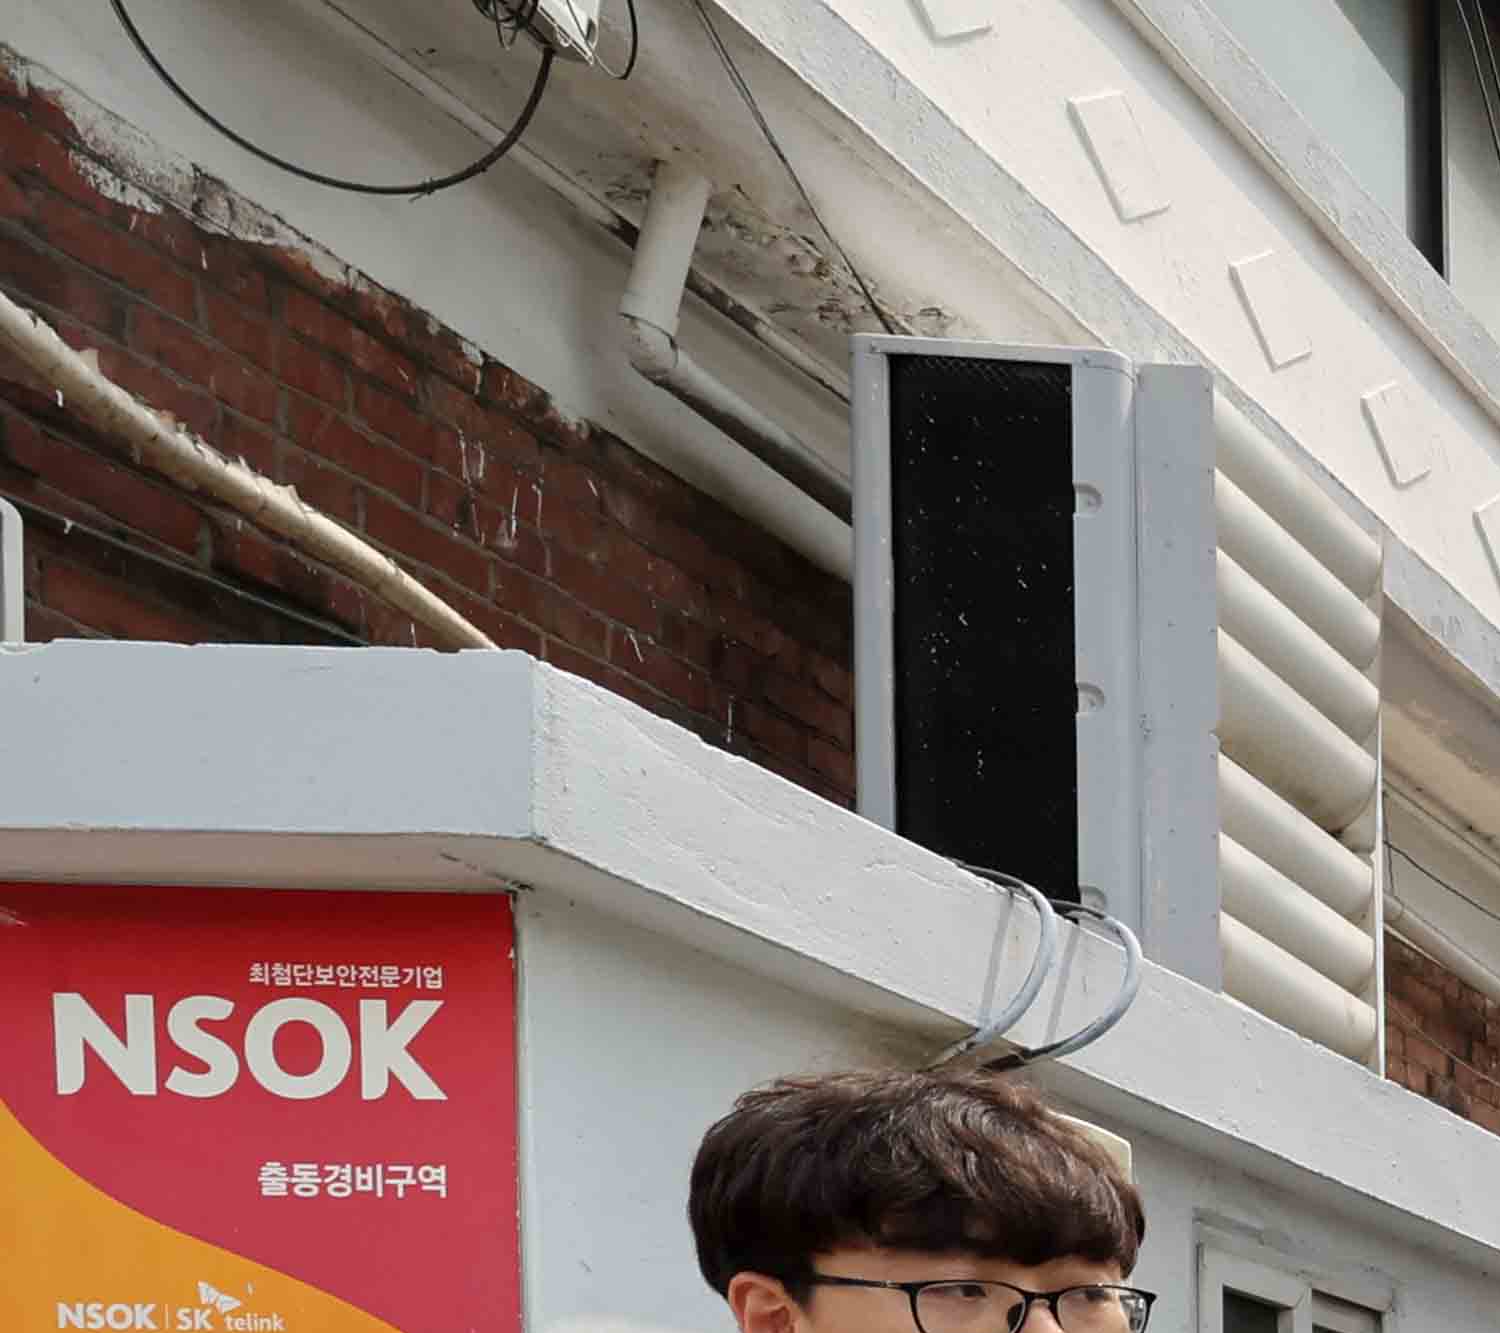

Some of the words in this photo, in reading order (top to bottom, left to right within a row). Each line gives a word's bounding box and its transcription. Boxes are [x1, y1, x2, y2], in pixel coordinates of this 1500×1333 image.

[249, 963, 443, 989] 최첨단보안전문기업
[52, 992, 449, 1101] NSOK
[257, 1162, 448, 1198] 출동경비구역
[57, 1303, 158, 1330] NSOK
[176, 1307, 213, 1330] SK
[224, 1312, 286, 1333] telink
